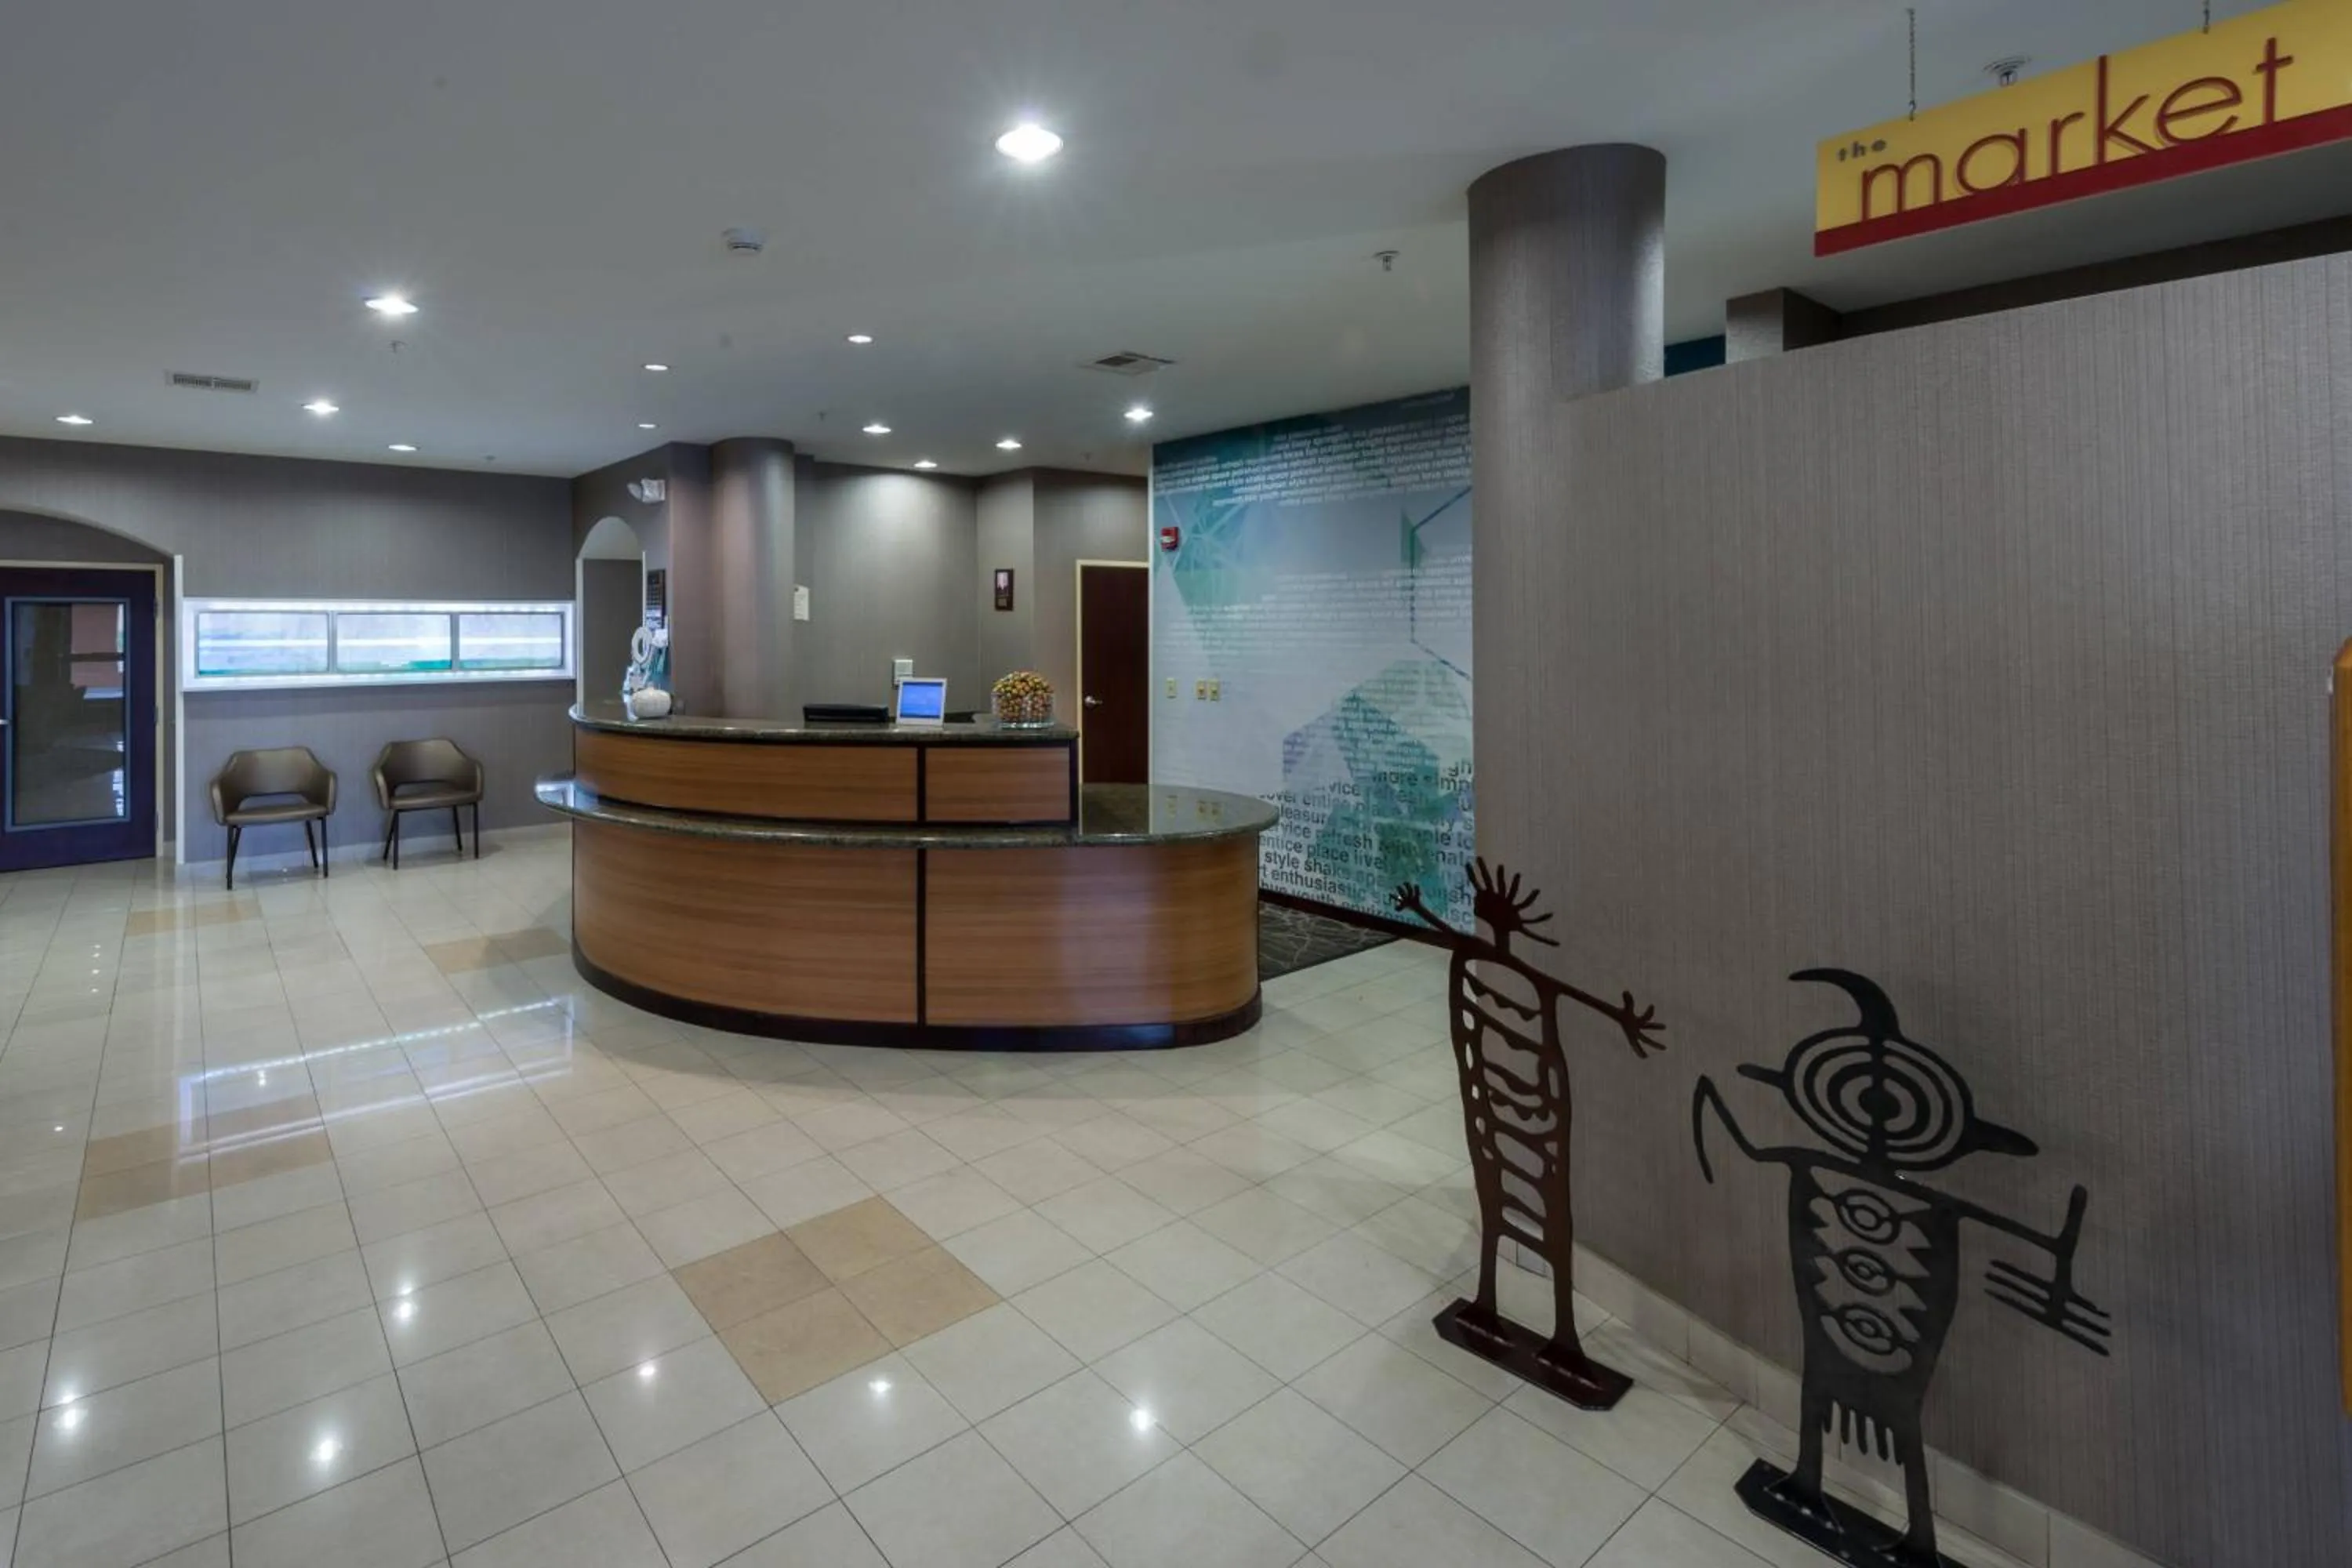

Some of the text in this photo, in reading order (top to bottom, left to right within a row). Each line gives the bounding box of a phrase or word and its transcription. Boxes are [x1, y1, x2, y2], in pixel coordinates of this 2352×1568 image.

[1860, 37, 2294, 222] market
[1838, 138, 1887, 162] the
[1265, 850, 1300, 869] style
[1271, 868, 1368, 905] enthusiastic
